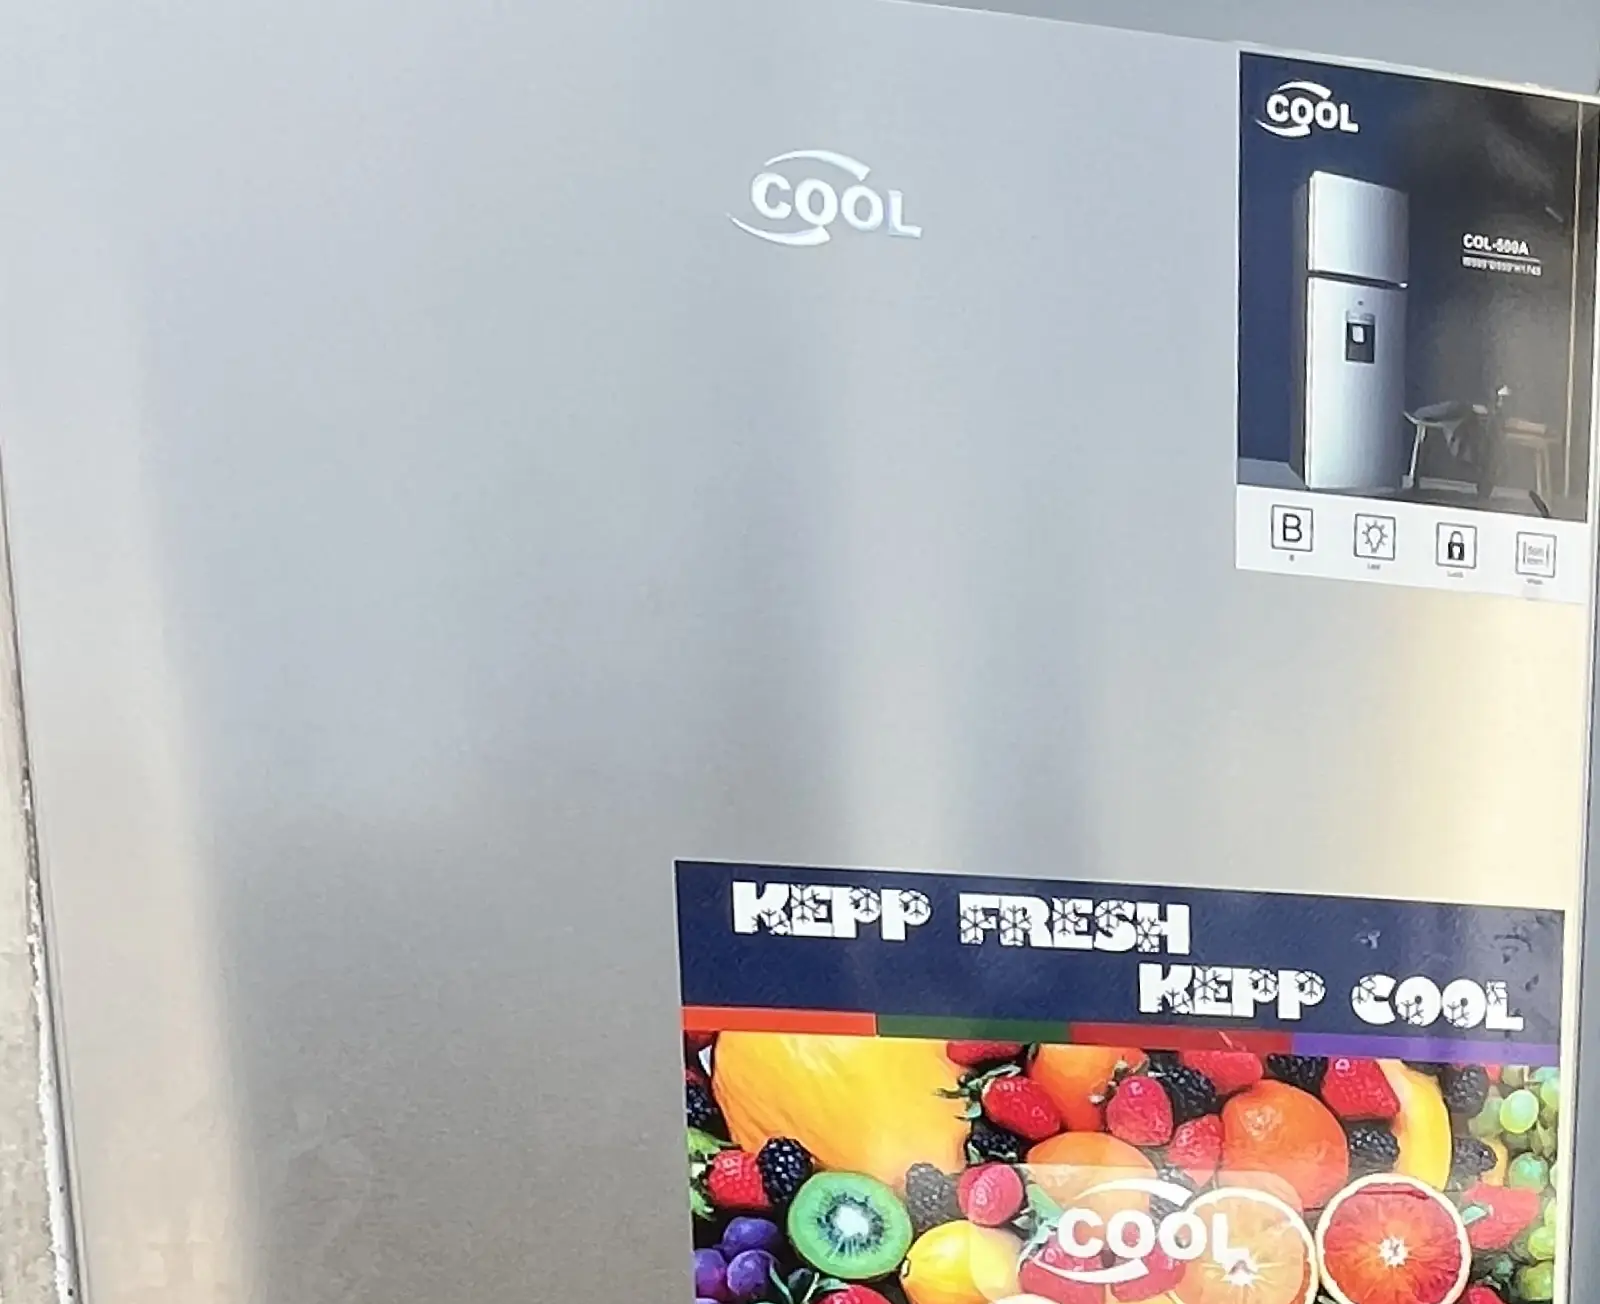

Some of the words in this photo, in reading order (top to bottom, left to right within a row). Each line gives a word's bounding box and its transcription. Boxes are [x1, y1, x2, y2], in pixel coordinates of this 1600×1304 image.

[1266, 93, 1359, 133] COOL
[751, 172, 922, 238] COOL
[1283, 513, 1302, 542] B
[732, 881, 931, 941] KEPP
[959, 893, 1190, 954] FRESH
[1138, 962, 1326, 1020] KEPP
[1351, 973, 1524, 1031] COOL
[1057, 1208, 1250, 1264] COOL
